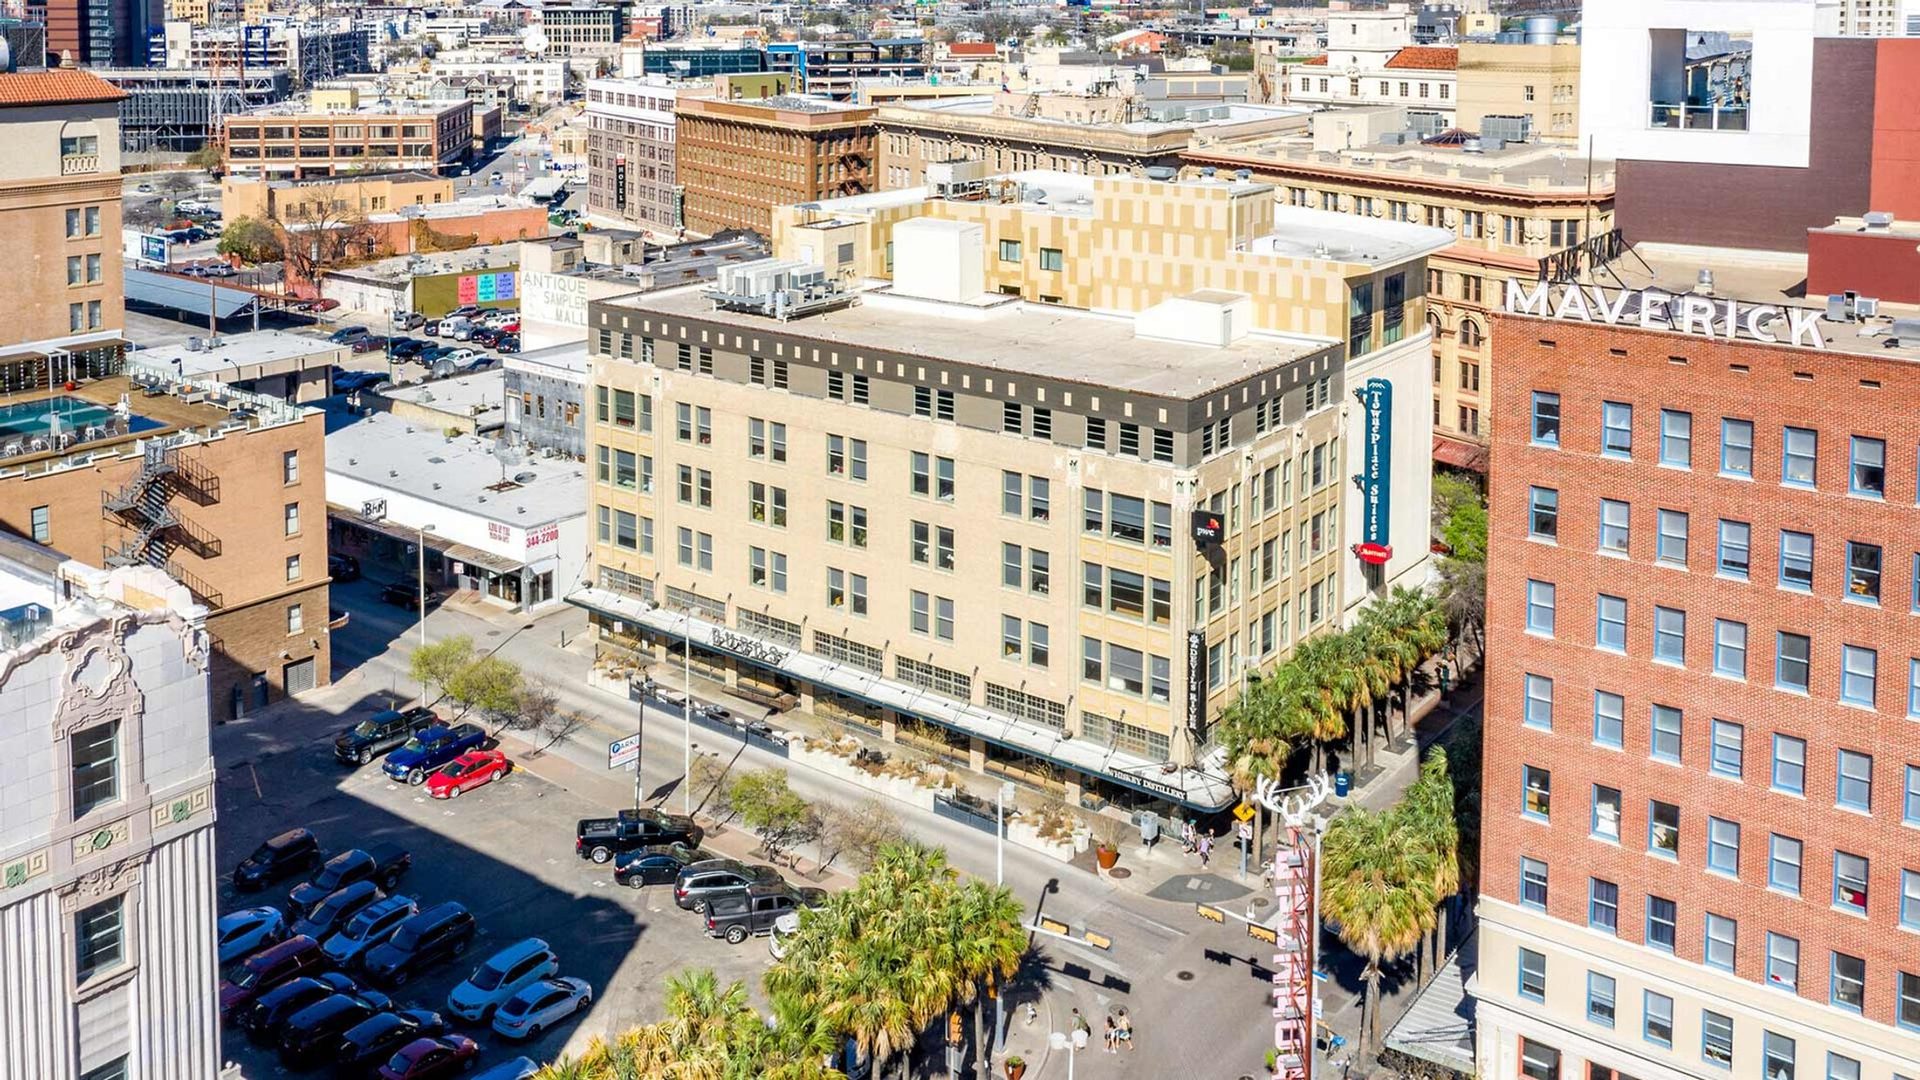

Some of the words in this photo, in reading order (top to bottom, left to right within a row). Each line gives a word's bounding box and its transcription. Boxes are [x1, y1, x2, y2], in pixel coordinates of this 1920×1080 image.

[523, 272, 587, 294] ANTIQUE
[543, 291, 587, 310] SAMPLER
[555, 307, 587, 326] MALL
[1506, 277, 1827, 348] MAVERICK
[1370, 391, 1381, 479] TownePlace
[1370, 485, 1379, 541] Suites
[526, 529, 559, 548] 344-2200
[1197, 528, 1215, 537] pwc
[1143, 781, 1185, 799] DISTILLERY
